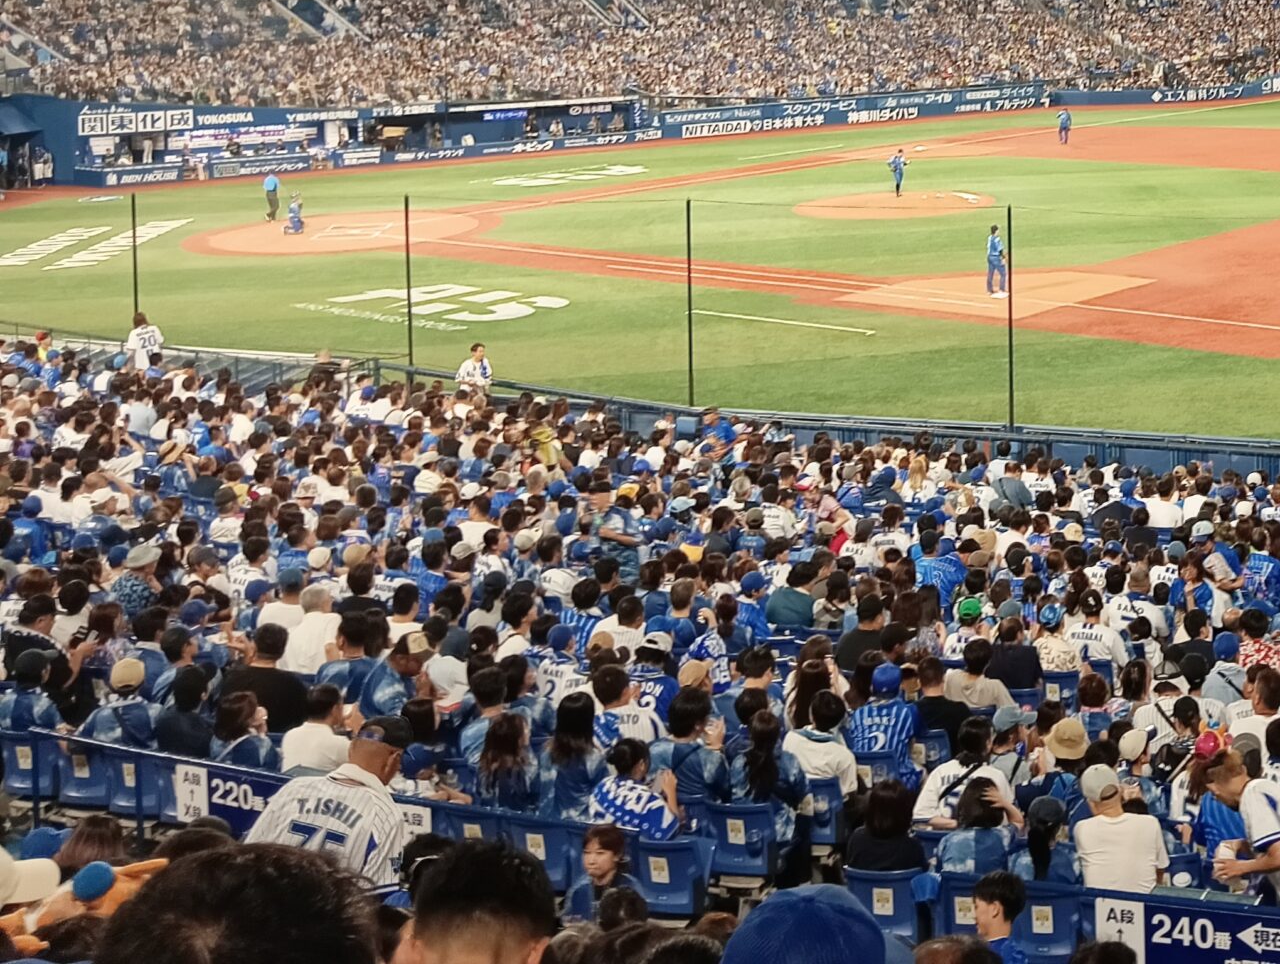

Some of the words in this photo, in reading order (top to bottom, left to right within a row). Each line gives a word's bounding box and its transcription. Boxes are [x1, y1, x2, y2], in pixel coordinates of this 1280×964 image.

[1163, 86, 1245, 103] エス歯科グループ
[783, 99, 858, 117] スタッフサービス
[847, 106, 919, 125] 神奈川ダイハツ
[81, 111, 192, 134] 関東化成
[684, 121, 748, 138] NITTAIDAI
[763, 115, 825, 132] 日本体育大学
[138, 334, 157, 349] 20
[544, 679, 557, 700] 2
[297, 797, 364, 827] T.ISHII
[1106, 906, 1135, 926] A段
